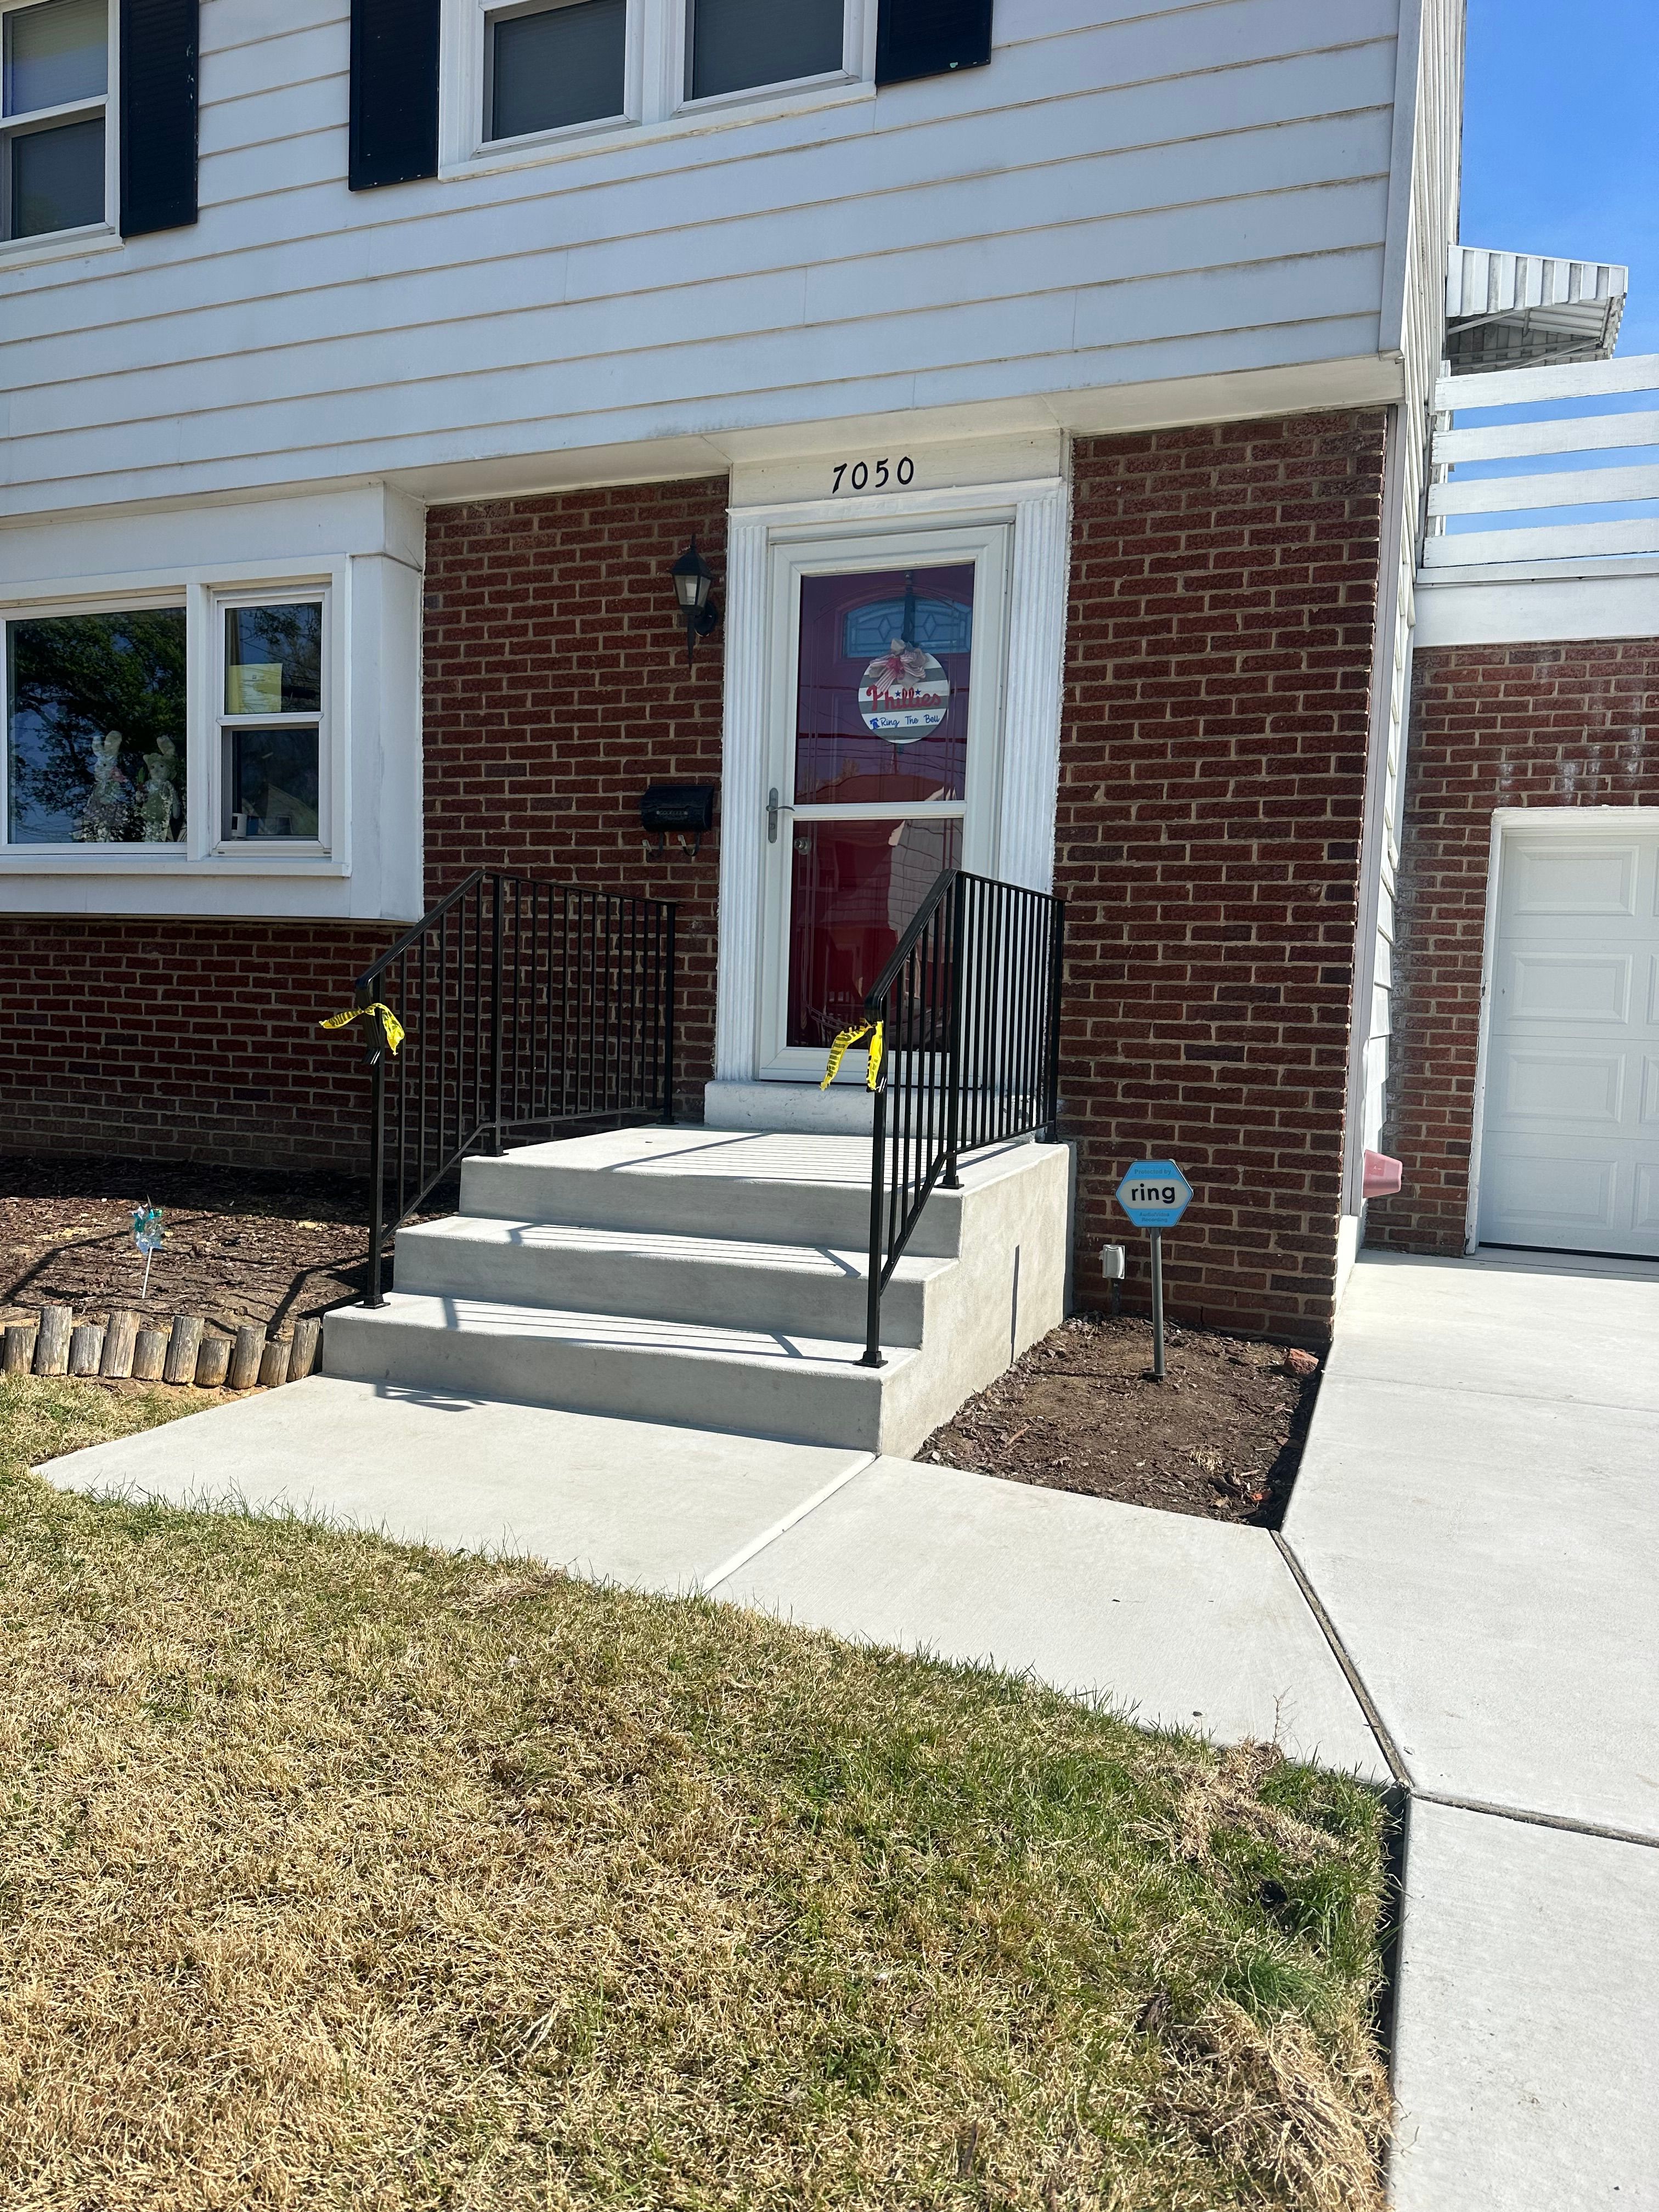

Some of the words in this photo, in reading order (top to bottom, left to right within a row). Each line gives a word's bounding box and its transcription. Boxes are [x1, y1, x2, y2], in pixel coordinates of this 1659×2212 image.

[832, 456, 914, 494] 7050
[866, 685, 942, 712] Phillies
[879, 718, 900, 728] Ring
[905, 716, 919, 725] The
[923, 714, 940, 723] Bell
[1131, 1183, 1175, 1204] ring
